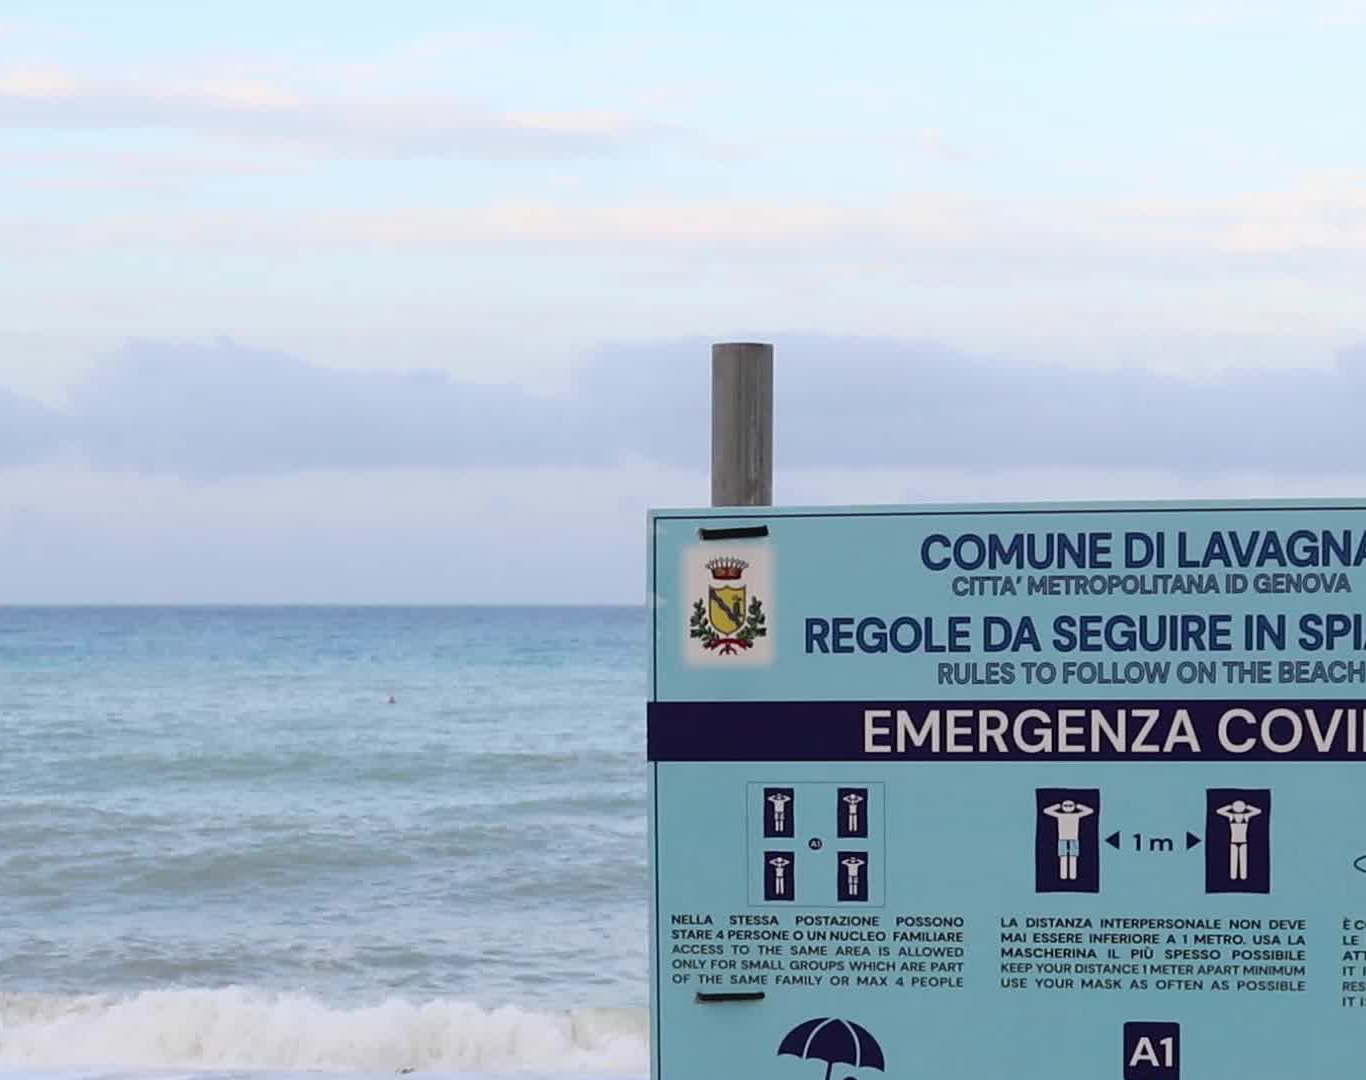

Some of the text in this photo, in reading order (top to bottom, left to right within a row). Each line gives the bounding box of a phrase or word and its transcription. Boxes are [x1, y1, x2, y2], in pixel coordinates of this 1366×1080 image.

[921, 533, 1111, 569] COMUNE
[1125, 532, 1164, 568] DI
[1028, 574, 1219, 595] METROPOLITANA
[1225, 573, 1247, 593] ID
[1253, 573, 1351, 593] GENOVA
[805, 617, 970, 653] REGOLE
[983, 616, 1040, 652] DA
[1053, 615, 1231, 651] SEGUIRE
[1245, 614, 1285, 650] IN
[938, 660, 1365, 684] RULES TO FOLLOW ON THE BEACH
[865, 709, 1199, 752] EMERGENZA
[1132, 833, 1173, 851] 1 m
[670, 913, 964, 927] NELLA STESSA POSTAZIONE POSSONO
[1000, 916, 1305, 929] LA DISTANZA INTERPERSONALE NON DEVE
[1342, 917, 1350, 930] È
[671, 928, 963, 942] STARE 4 PERSONE O UN NUCLEO FAMILIARE
[1000, 931, 1306, 945] MAI ESSERE INFERIORE A 1 METRO. USA LA
[1341, 995, 1355, 1006] IT
[1130, 1037, 1172, 1066] A1
